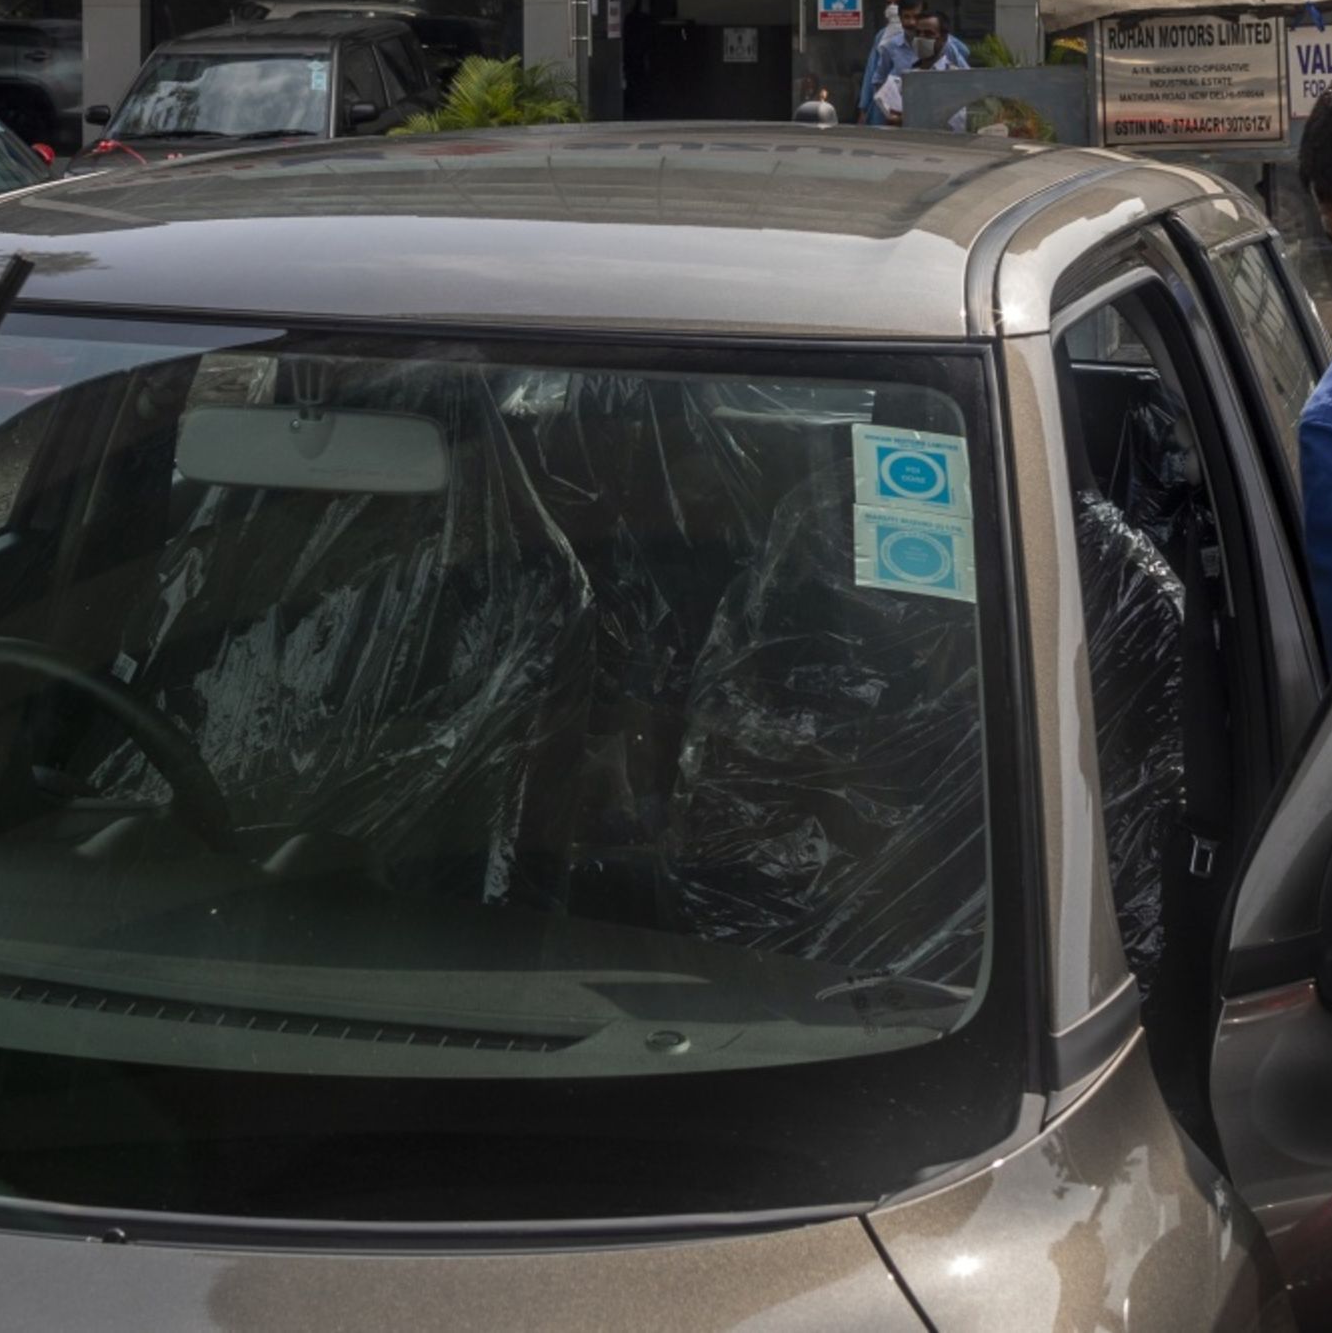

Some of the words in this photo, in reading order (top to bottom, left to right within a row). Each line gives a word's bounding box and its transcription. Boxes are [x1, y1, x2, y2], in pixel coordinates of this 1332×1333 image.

[1107, 25, 1155, 50] ROHAN
[1158, 24, 1215, 48] MOTORS
[1218, 22, 1272, 45] LIMITED
[1149, 79, 1200, 89] INDUSTRIAL
[1201, 77, 1233, 87] ESTATE
[1115, 120, 1147, 136] GSTIN
